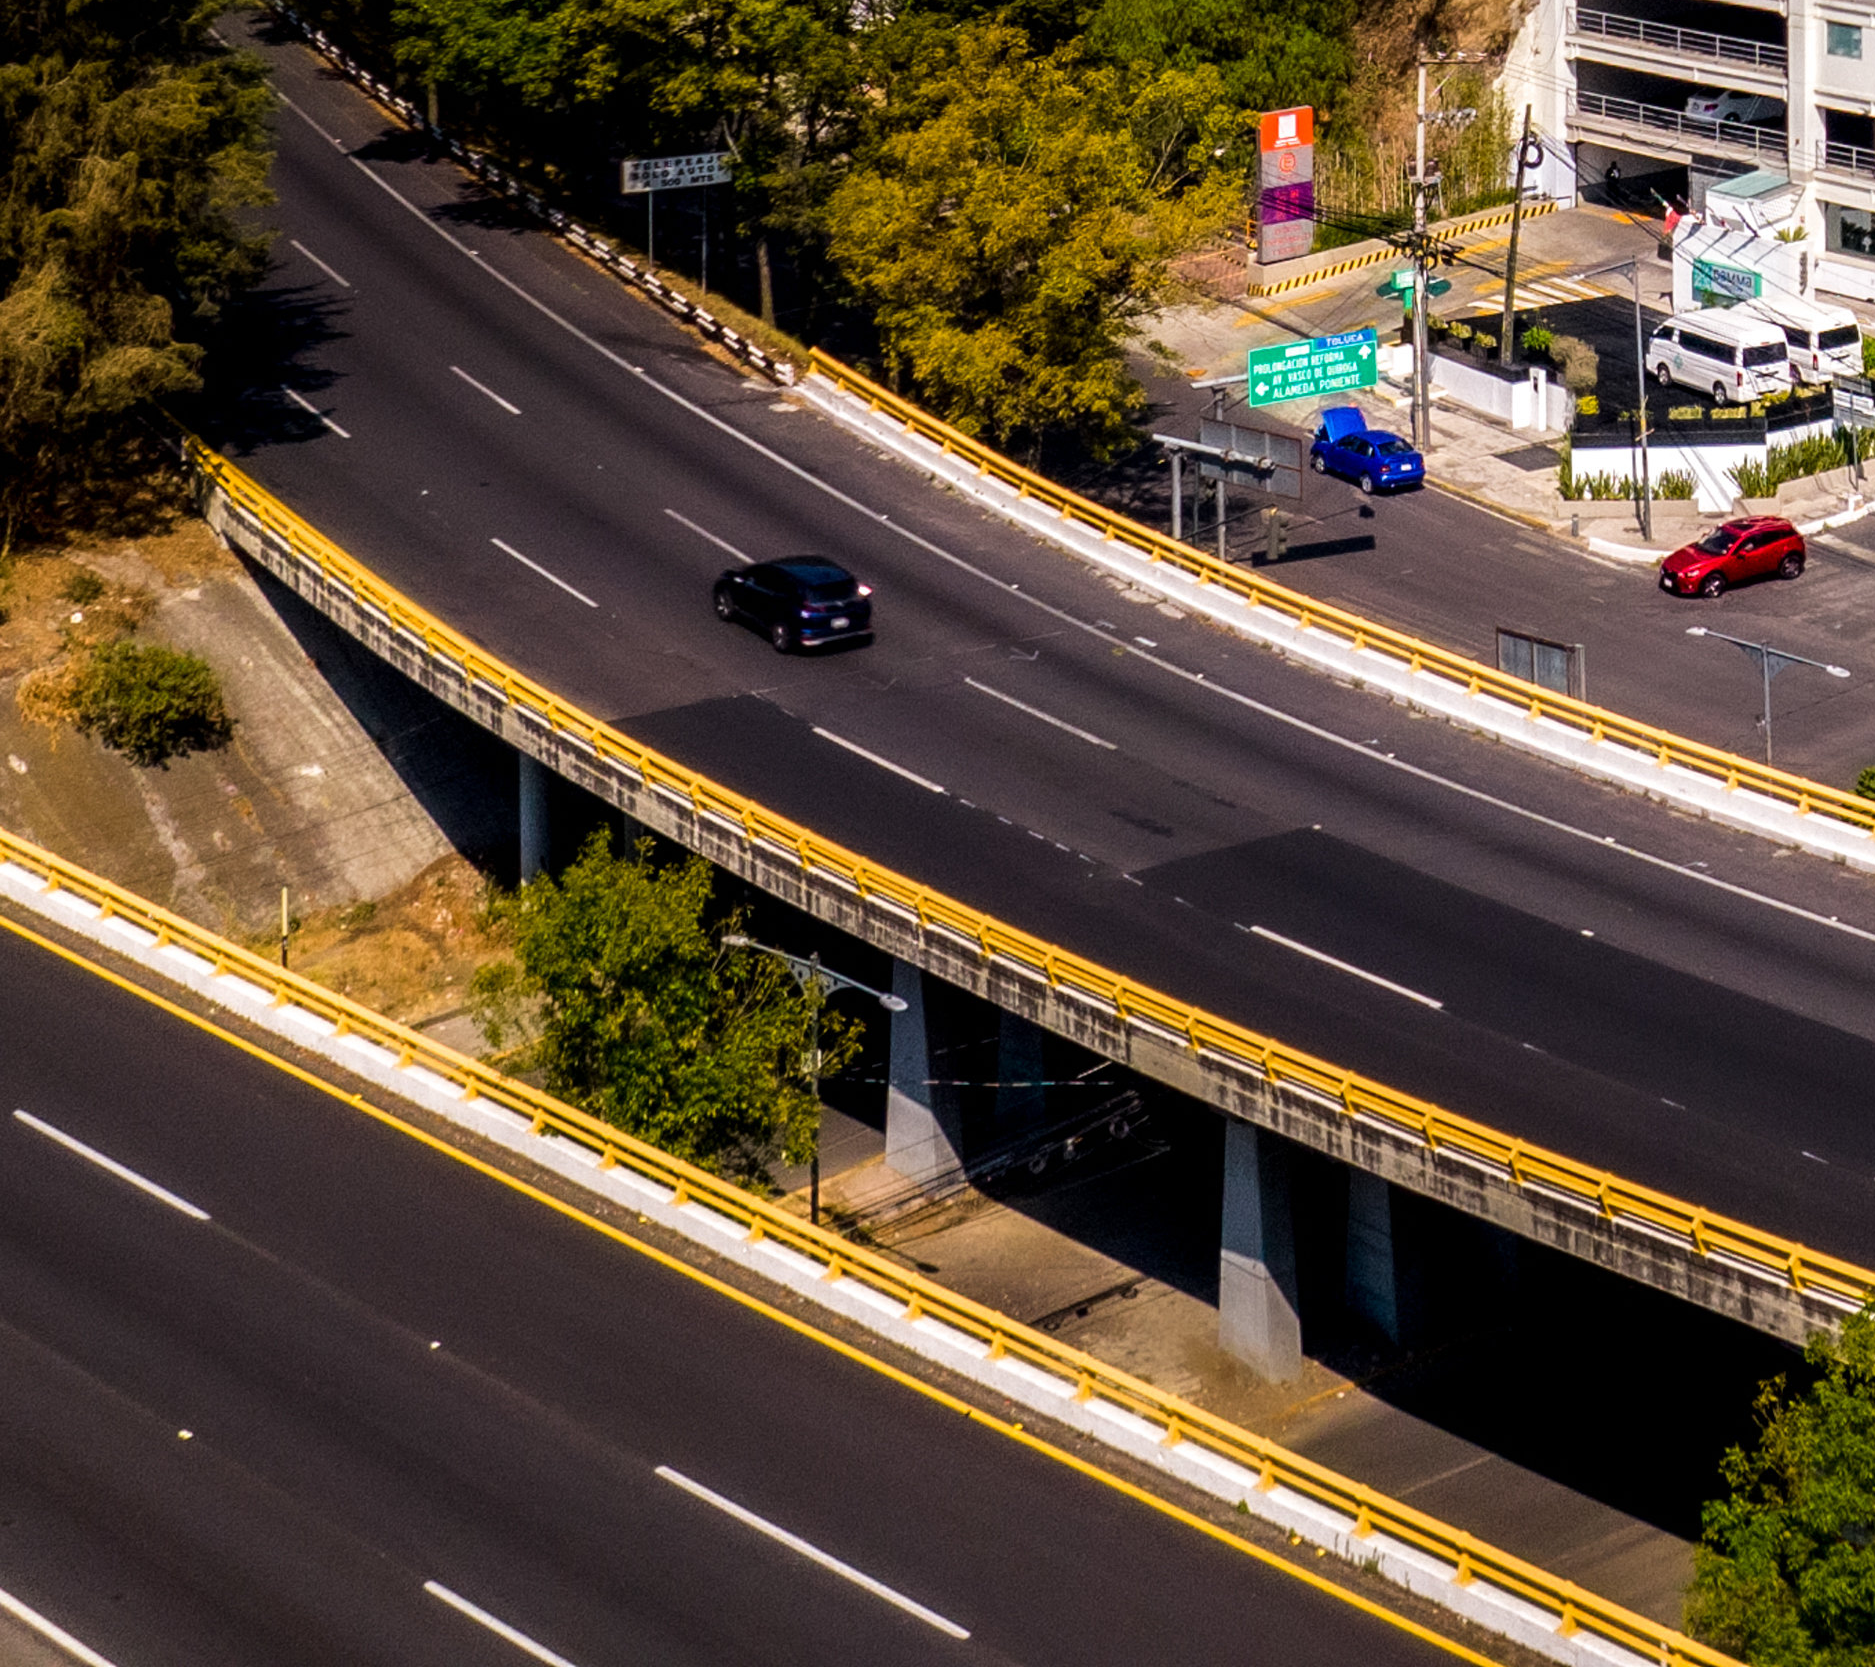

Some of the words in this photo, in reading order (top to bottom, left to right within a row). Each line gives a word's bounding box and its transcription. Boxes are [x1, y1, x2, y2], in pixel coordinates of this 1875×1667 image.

[630, 169, 670, 181] SOLO
[1326, 333, 1364, 347] TOLUCA
[1310, 351, 1345, 366] REFORMA
[1288, 368, 1312, 383] VASCO
[1314, 366, 1324, 379] DE
[1326, 361, 1358, 376] QUIROGA
[1272, 381, 1315, 399] ALAMEDA
[1319, 373, 1361, 391] PONIENTE
